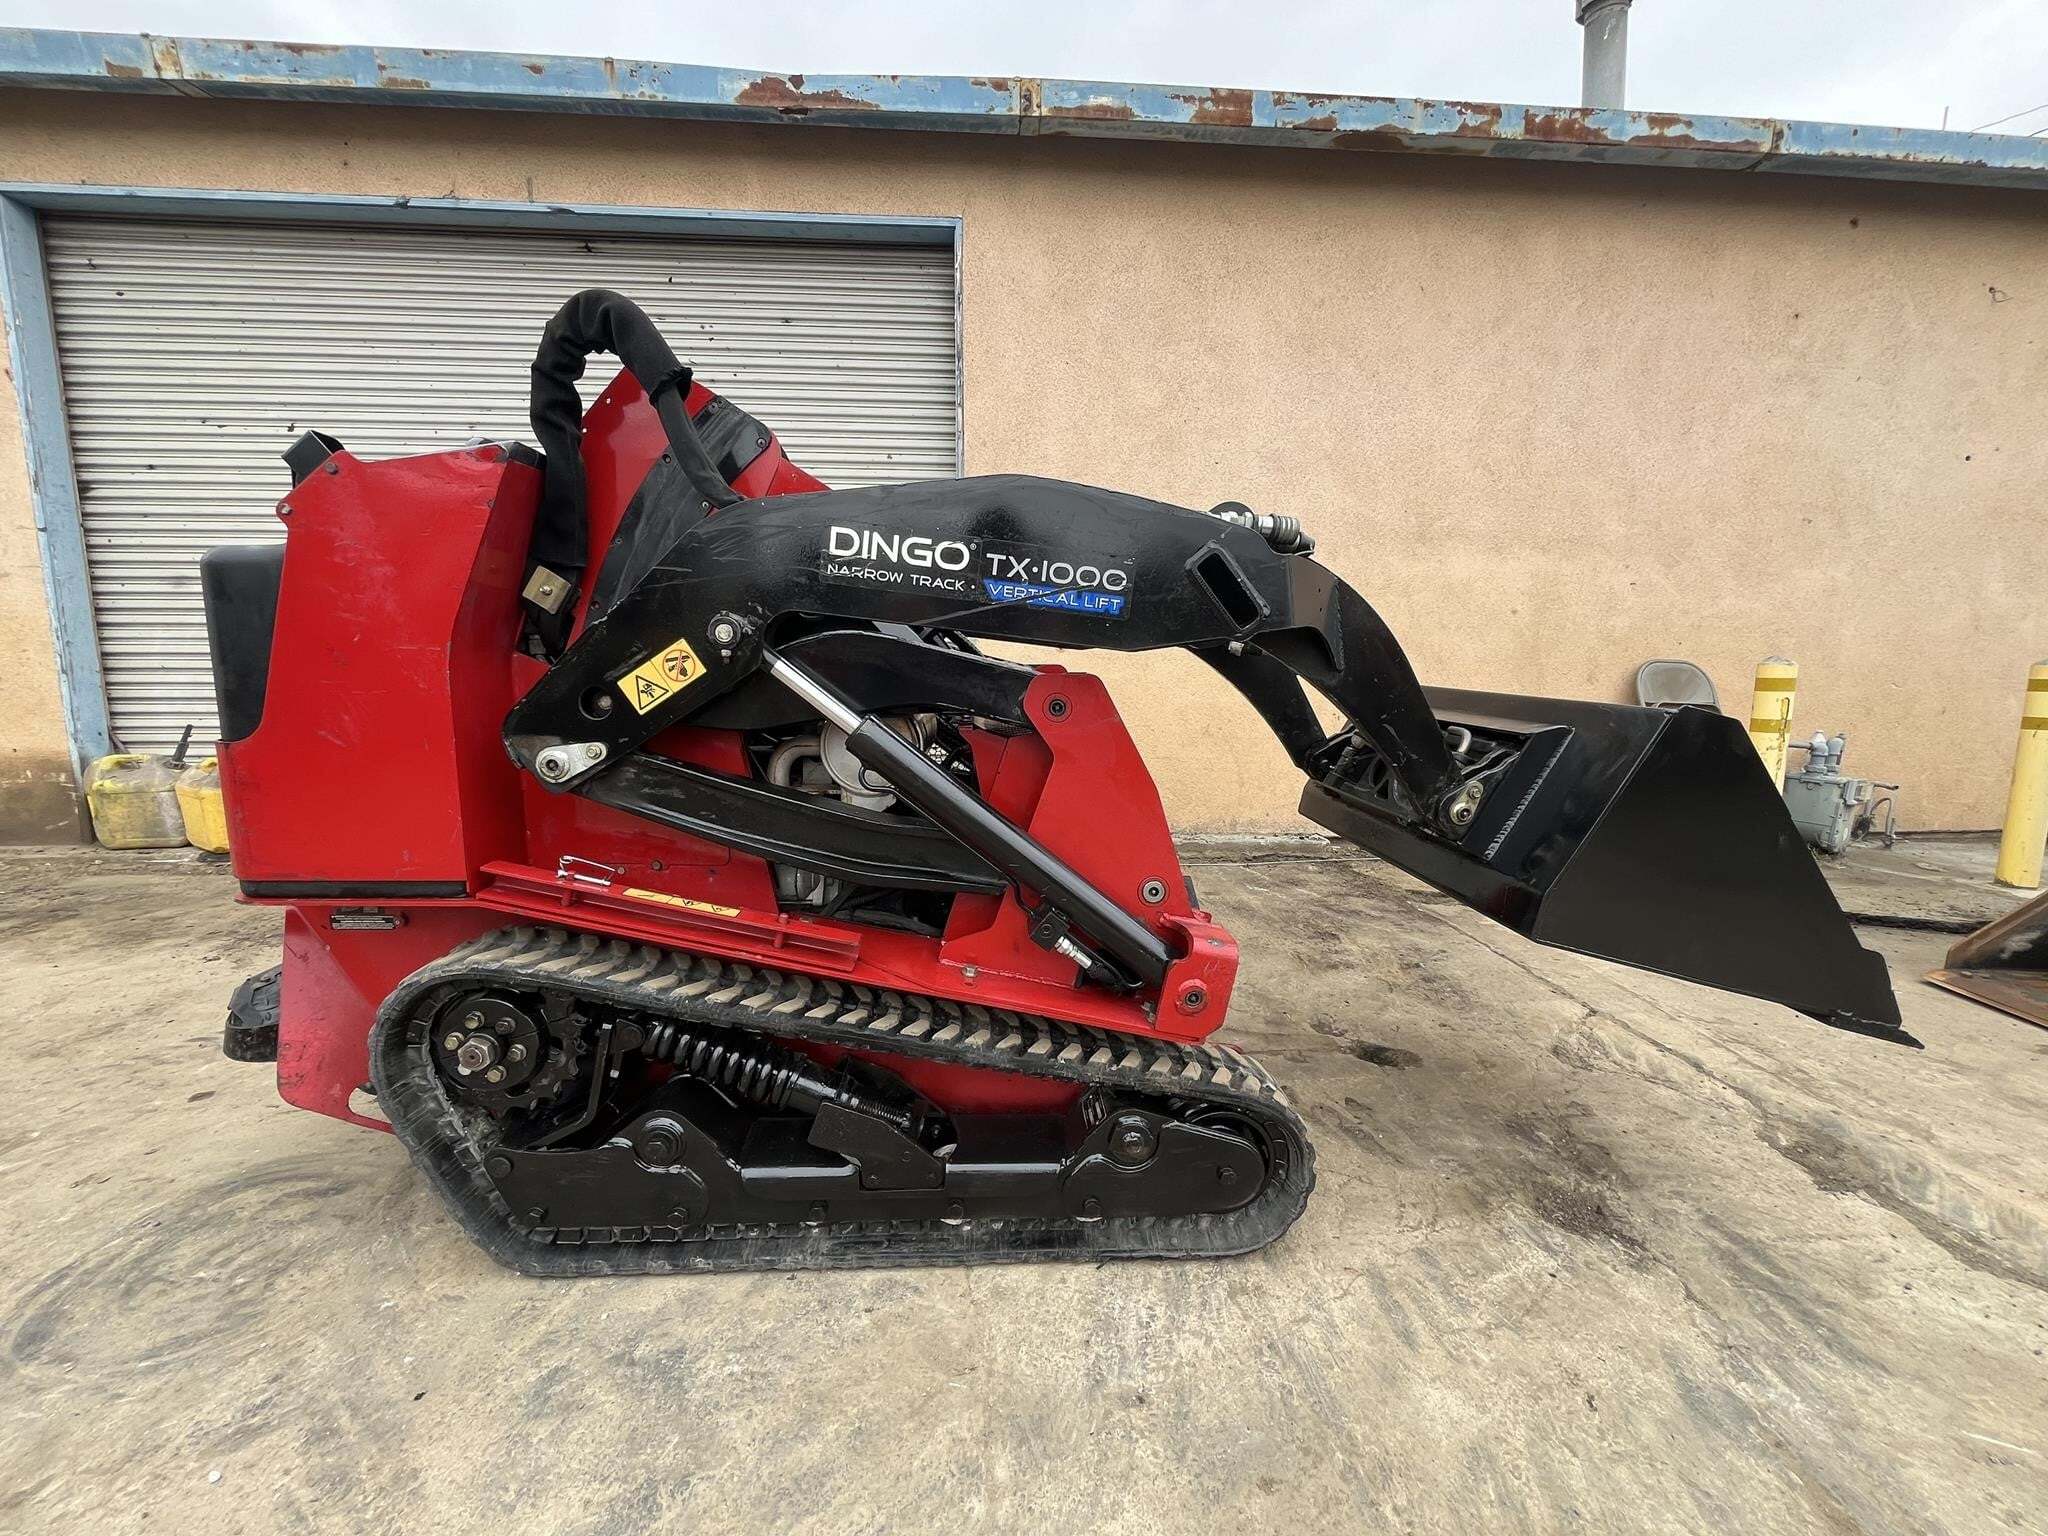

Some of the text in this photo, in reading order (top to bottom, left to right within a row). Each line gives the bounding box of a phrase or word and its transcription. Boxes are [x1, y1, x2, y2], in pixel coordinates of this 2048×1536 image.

[829, 525, 970, 571] DINGO
[827, 563, 965, 592] NARROW TRACK
[1085, 592, 1121, 611] LIFT
